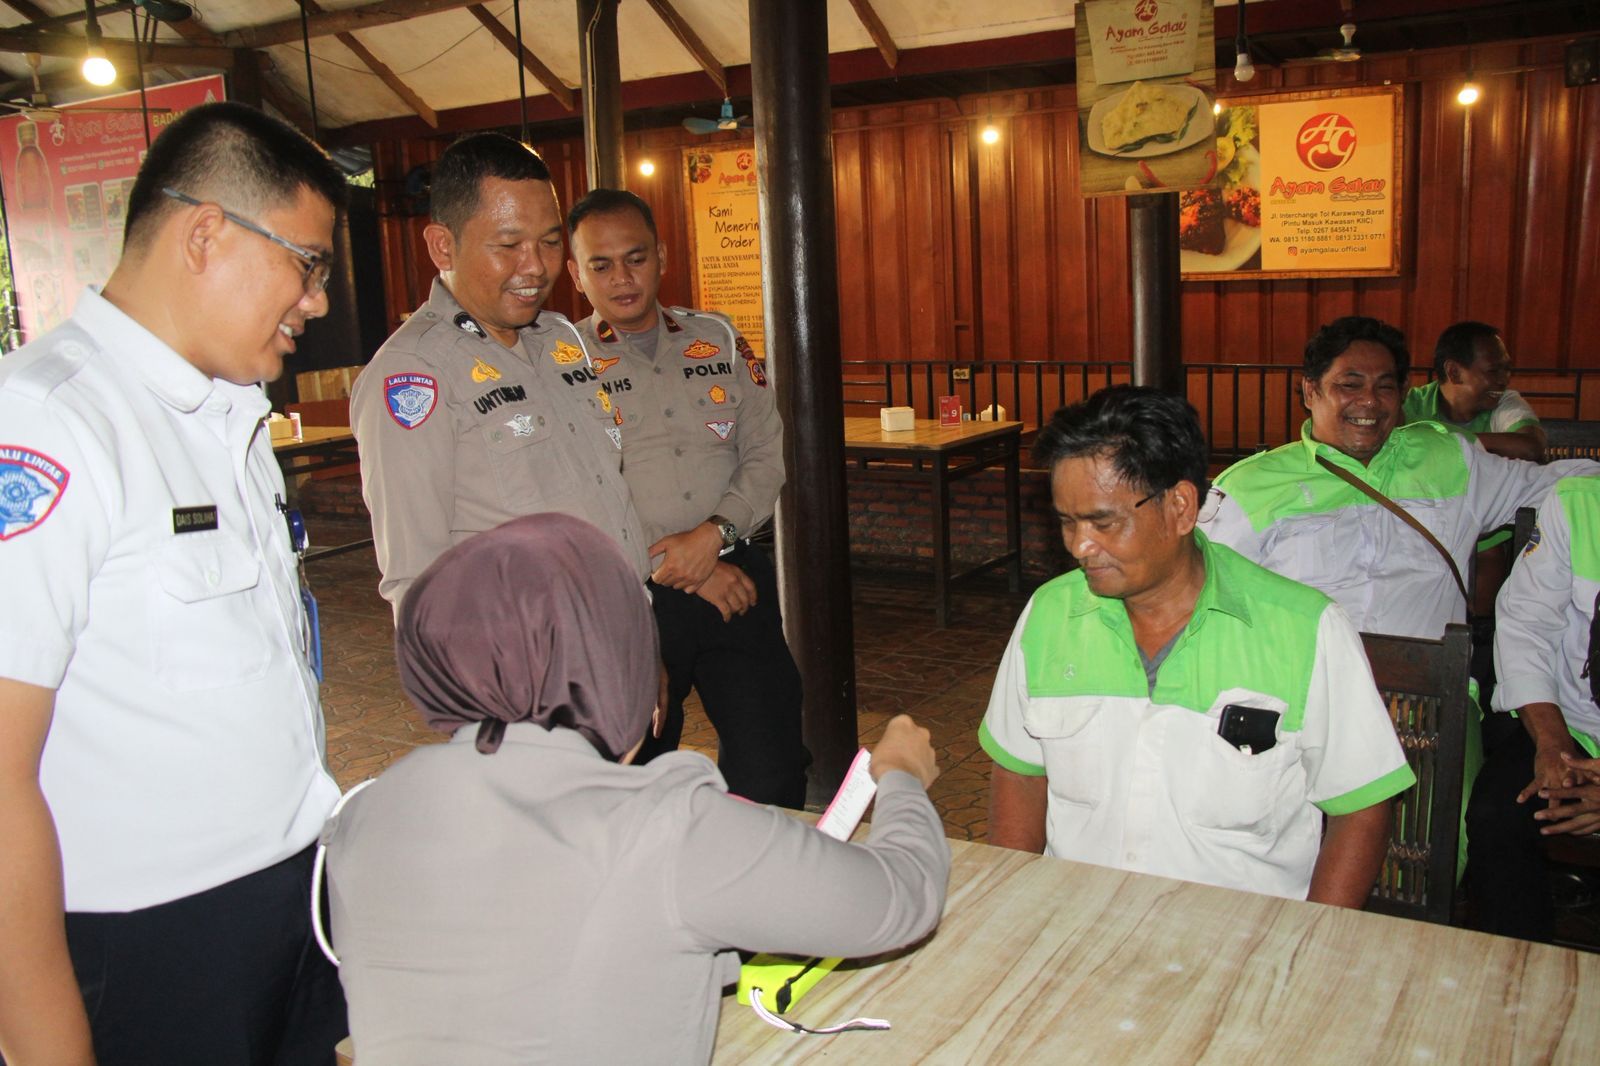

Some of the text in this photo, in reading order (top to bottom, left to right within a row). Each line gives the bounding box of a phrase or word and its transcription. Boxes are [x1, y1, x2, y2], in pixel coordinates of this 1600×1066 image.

[1105, 25, 1144, 42] Ayam
[1148, 20, 1187, 35] Galau
[1268, 176, 1325, 200] Ayam
[1328, 176, 1386, 194] Galau
[708, 202, 733, 218] Kami
[1279, 211, 1318, 219] Interchange
[1320, 210, 1330, 218] Tol
[1331, 210, 1365, 218] Karawang
[1366, 208, 1385, 216] Barat
[1302, 219, 1323, 227] Masuk
[1324, 218, 1355, 226] Kawasan
[720, 234, 755, 249] Order
[723, 261, 739, 269] ANDA
[682, 361, 732, 380] POLRI
[388, 375, 433, 386] LALU LINTAS
[951, 409, 958, 417] 9
[24, 451, 63, 481] LINTAS
